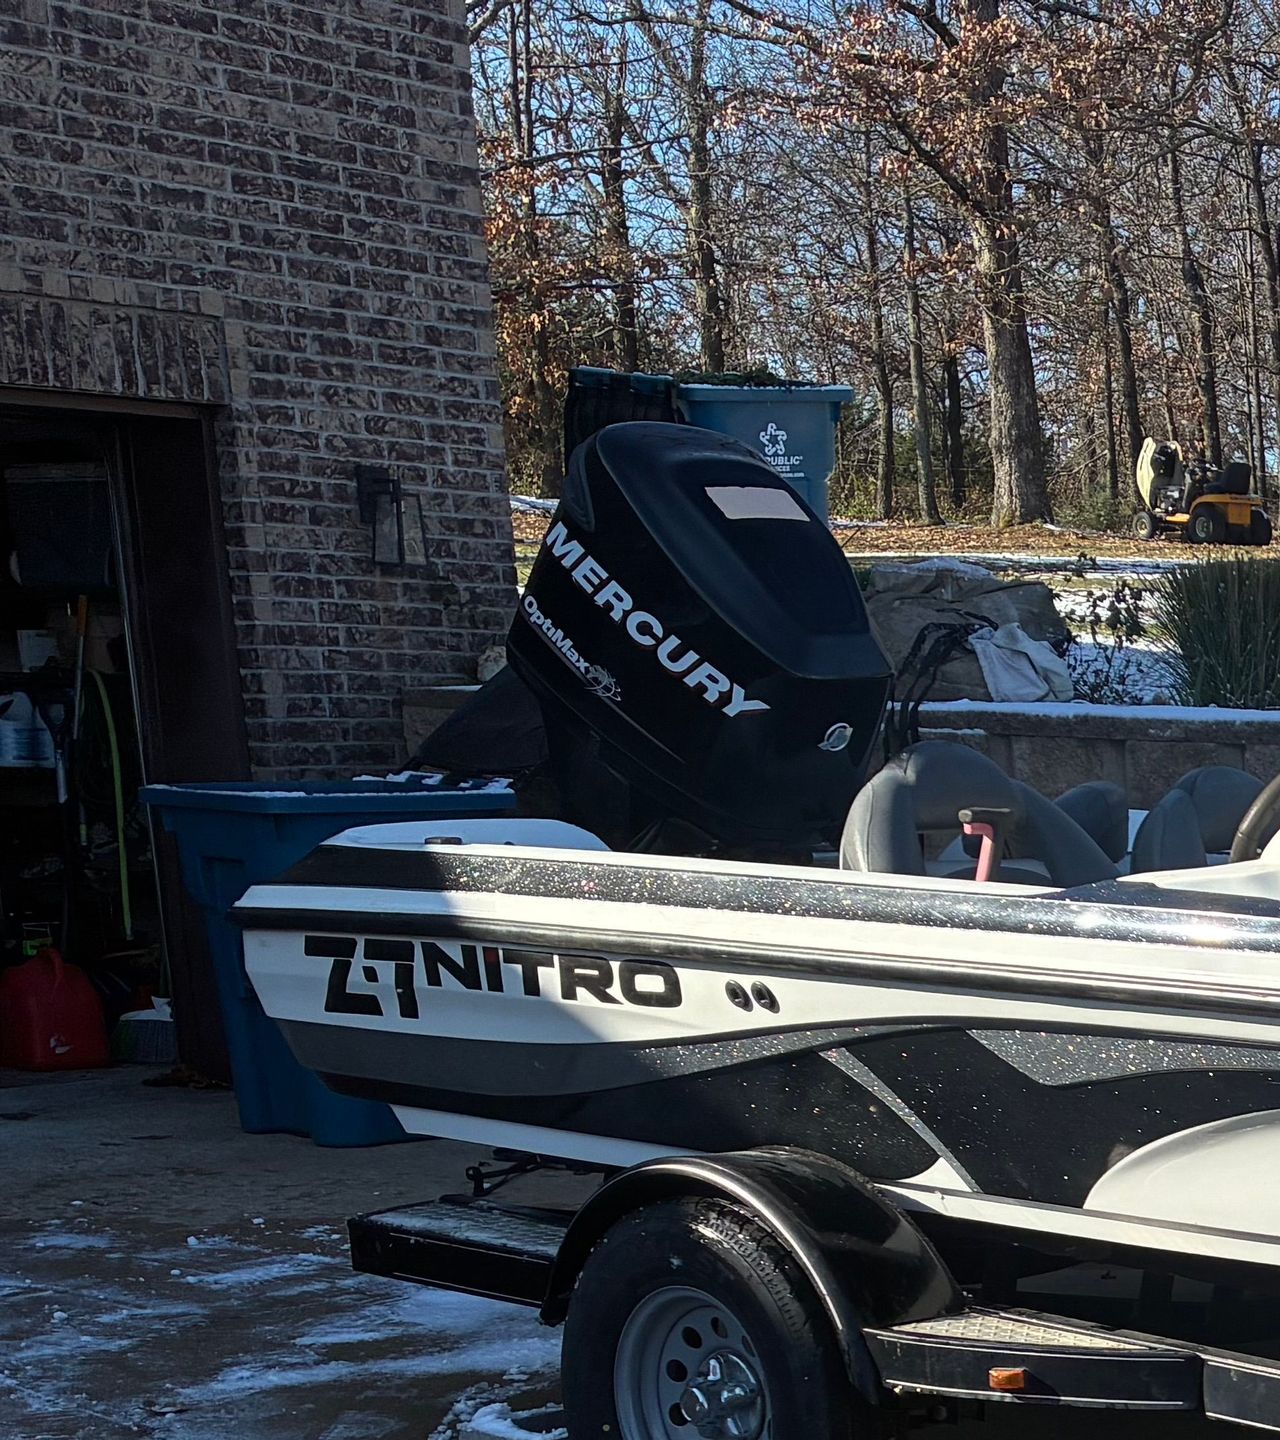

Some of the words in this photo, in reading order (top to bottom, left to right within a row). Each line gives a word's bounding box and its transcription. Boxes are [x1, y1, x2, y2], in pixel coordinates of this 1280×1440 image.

[524, 595, 590, 674] OptiMax
[545, 520, 771, 718] MERCURY
[420, 940, 684, 1009] NITRO
